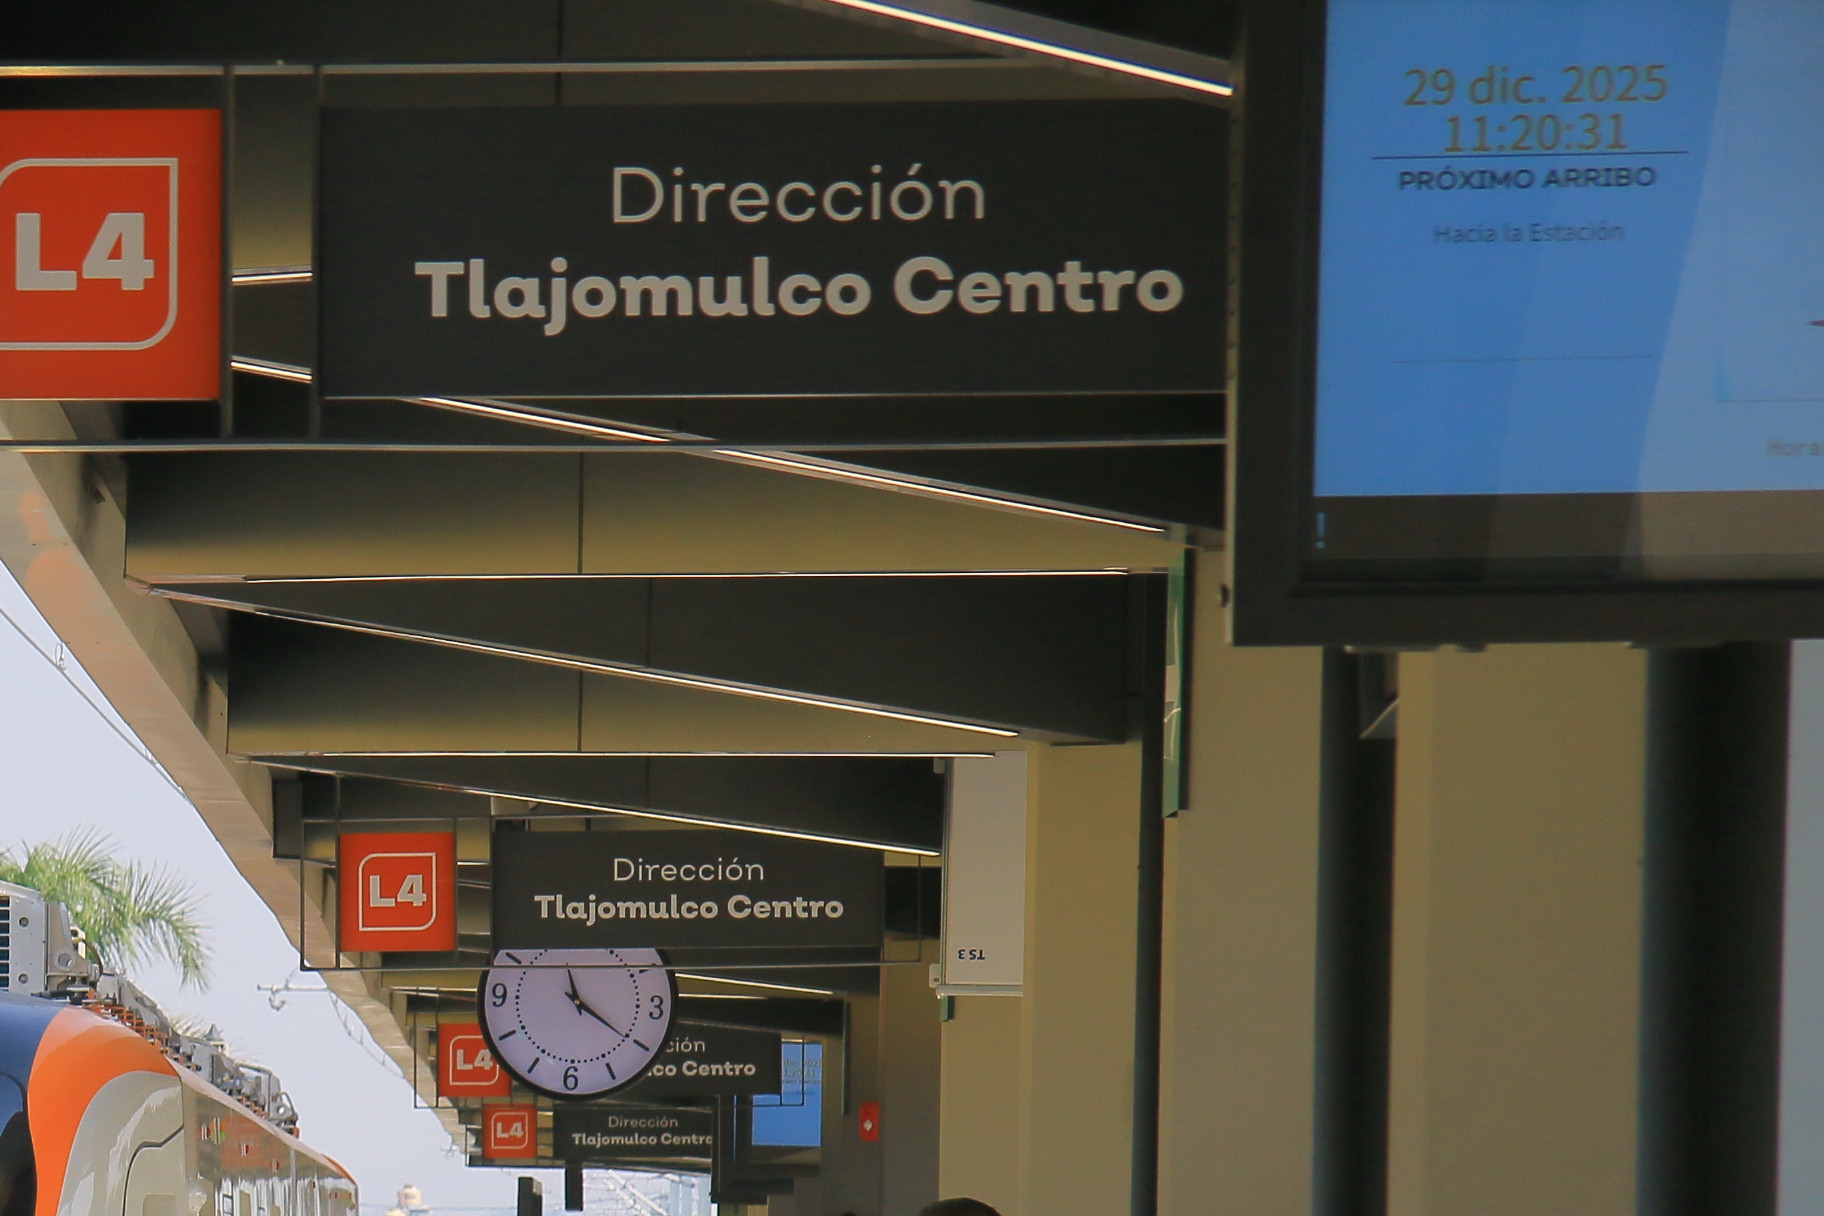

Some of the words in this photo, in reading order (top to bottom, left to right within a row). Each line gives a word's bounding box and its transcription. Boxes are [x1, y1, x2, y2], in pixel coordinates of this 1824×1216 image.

[1403, 67, 1456, 107] 29
[1468, 65, 1547, 105] dic.
[1561, 63, 1670, 103] 2025
[1443, 112, 1627, 152] 11:20:31
[1398, 164, 1535, 191] PRÓXIMO
[1542, 166, 1657, 188] ARRIBO
[612, 162, 986, 224] Dirección
[1434, 222, 1498, 243] Hacia
[1504, 222, 1524, 242] la
[1530, 219, 1625, 242] Estación
[15, 212, 155, 291] L4
[414, 256, 872, 336] Tlajomulco
[893, 256, 1184, 315] Centro
[613, 856, 764, 882] Dirección
[369, 874, 427, 908] L4
[533, 894, 719, 926] Tlajomulco
[727, 895, 844, 919] Centro
[491, 983, 508, 1008] 9
[649, 995, 664, 1020] 3
[456, 1048, 494, 1071] L4
[682, 1060, 757, 1077] Centro
[563, 1066, 579, 1091] 6
[496, 1122, 524, 1138] L4
[608, 1114, 679, 1128] Dirección
[572, 1133, 658, 1148] Tlajomulco
